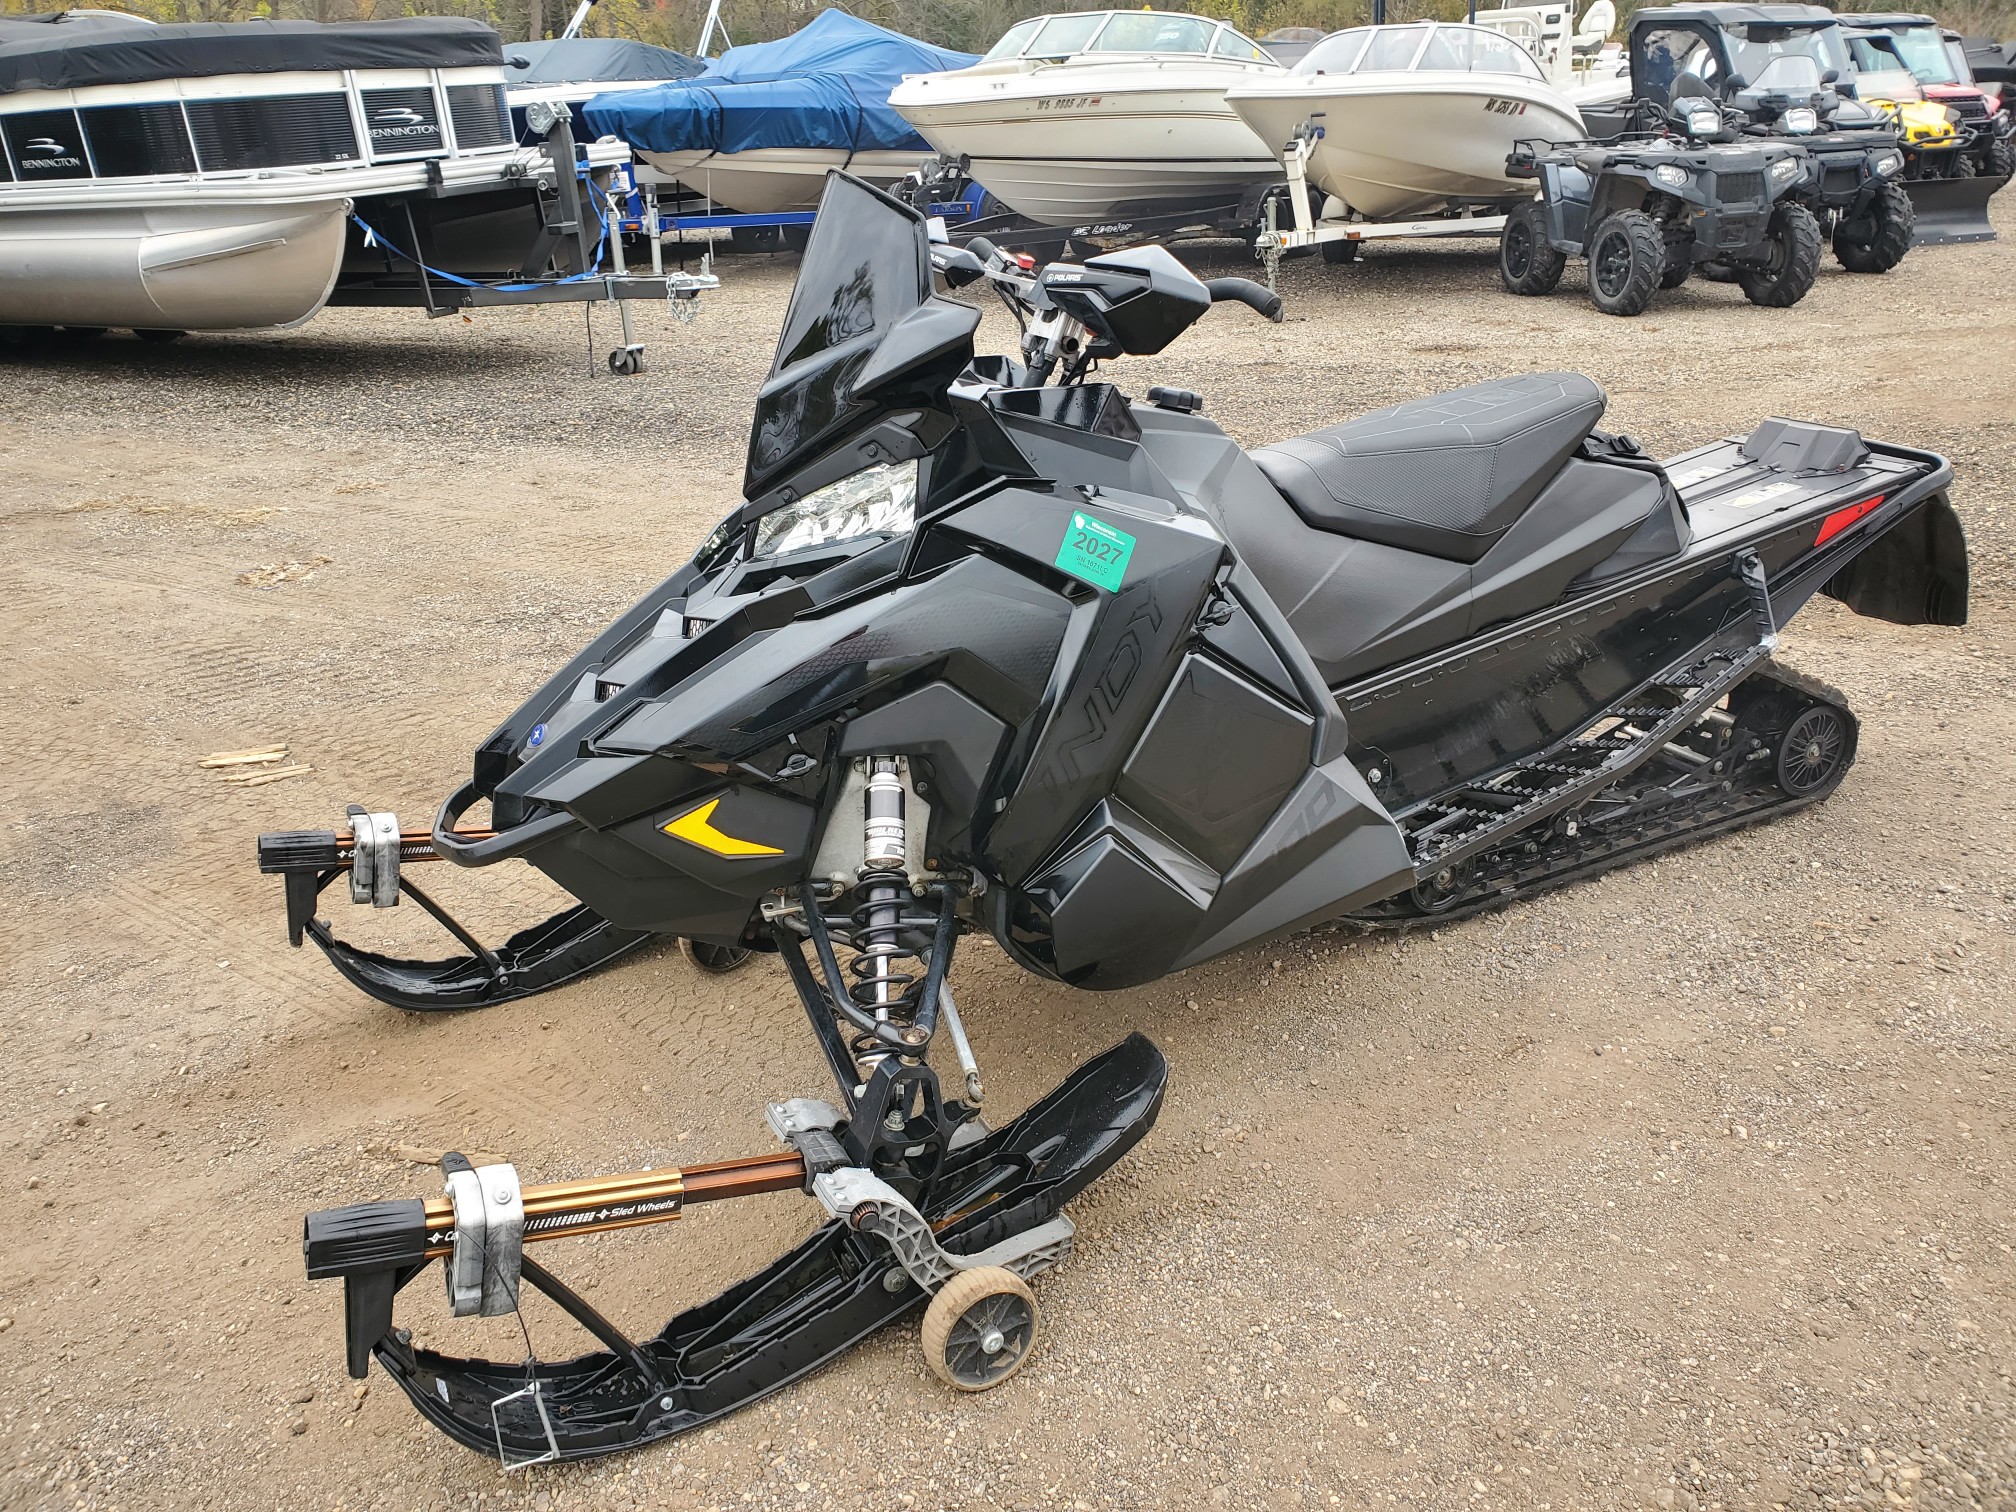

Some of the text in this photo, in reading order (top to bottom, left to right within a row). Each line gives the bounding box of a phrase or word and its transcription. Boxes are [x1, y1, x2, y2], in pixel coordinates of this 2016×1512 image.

[368, 125, 439, 138] BENNINGTON
[21, 157, 80, 169] BENNINGTON
[1054, 273, 1083, 282] POLARIS
[1091, 521, 1117, 538] Wisconsin
[1072, 532, 1124, 565] 2027
[1076, 554, 1109, 574] SN 1071LC
[609, 1200, 676, 1218] Sled Wheels
